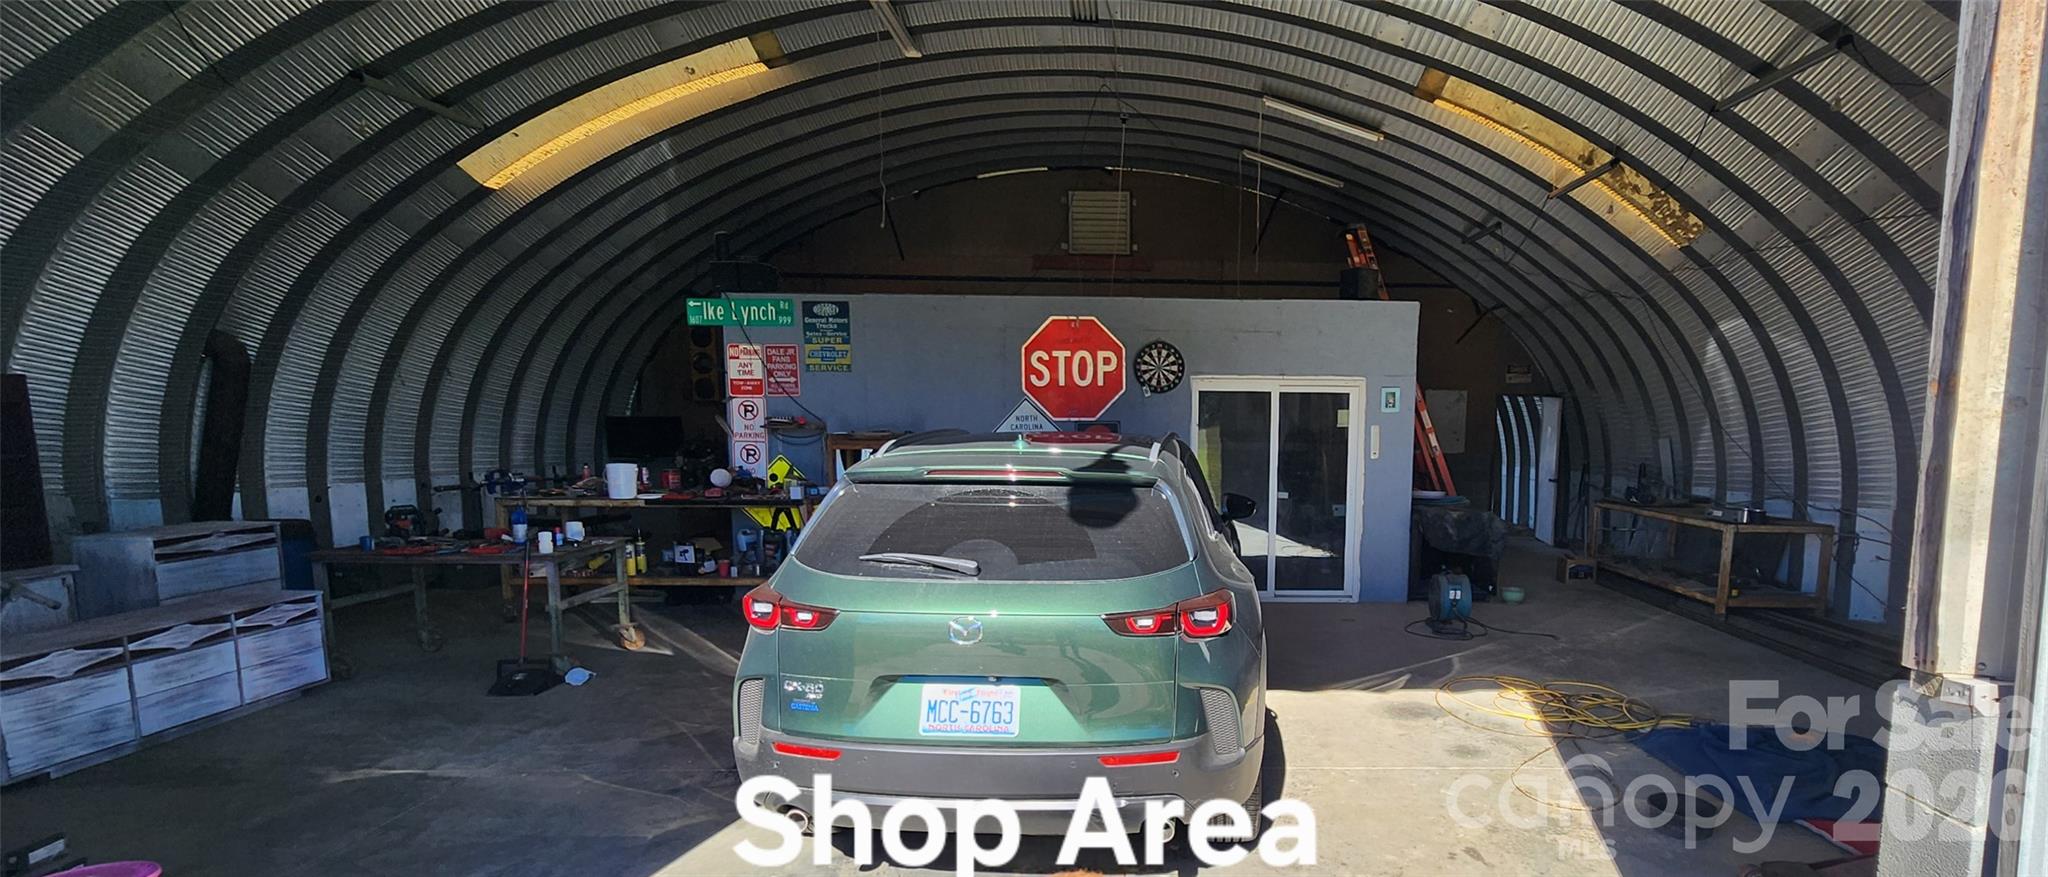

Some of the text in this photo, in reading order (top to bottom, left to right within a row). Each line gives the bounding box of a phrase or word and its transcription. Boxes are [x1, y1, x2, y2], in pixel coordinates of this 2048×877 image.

[703, 301, 724, 320] Ike
[731, 301, 776, 325] Lynch
[729, 346, 739, 358] NO
[737, 369, 753, 377] TIME
[1030, 350, 1118, 388] STOP
[1010, 423, 1044, 431] CAROLINA
[734, 432, 765, 440] PARKING
[926, 699, 1014, 725] MCC-6763
